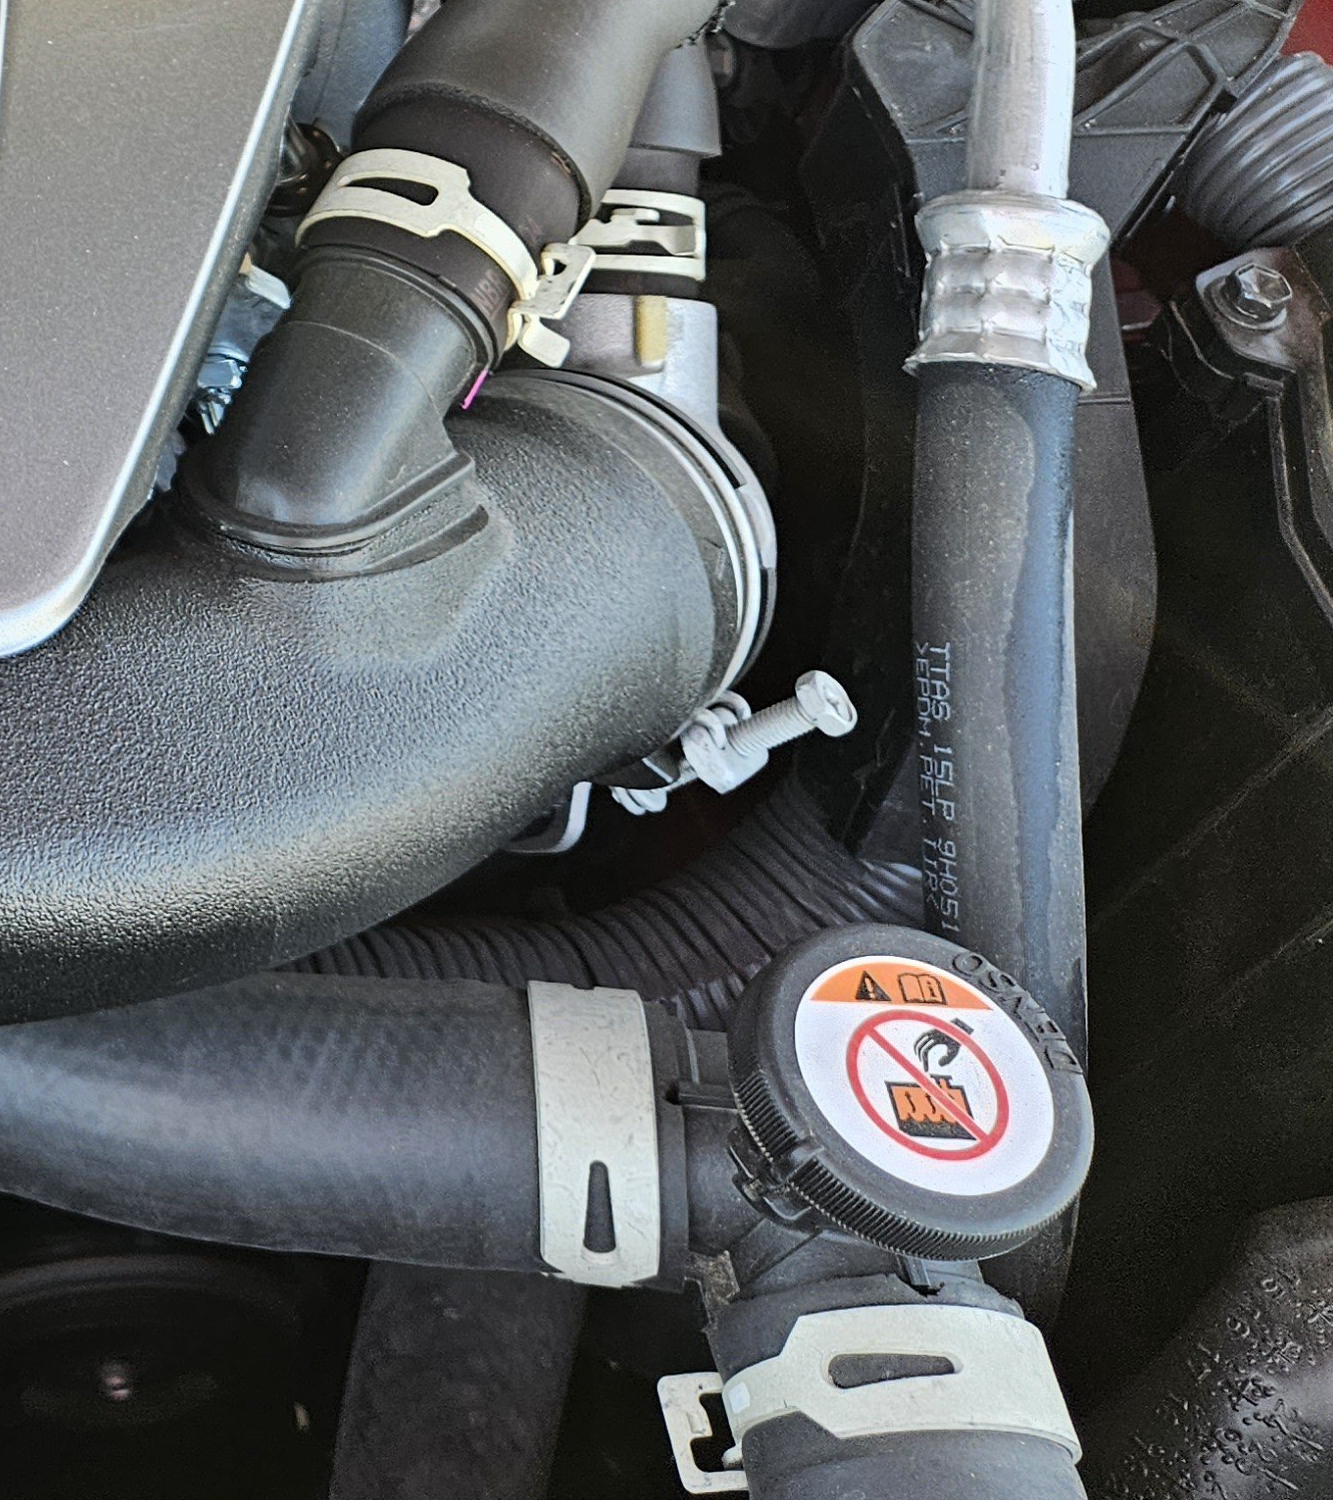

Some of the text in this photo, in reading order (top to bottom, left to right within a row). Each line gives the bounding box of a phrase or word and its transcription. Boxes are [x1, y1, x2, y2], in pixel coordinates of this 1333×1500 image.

[930, 641, 952, 722] TTAS
[937, 837, 961, 933] 9H051
[952, 952, 1083, 1075] DENSO
